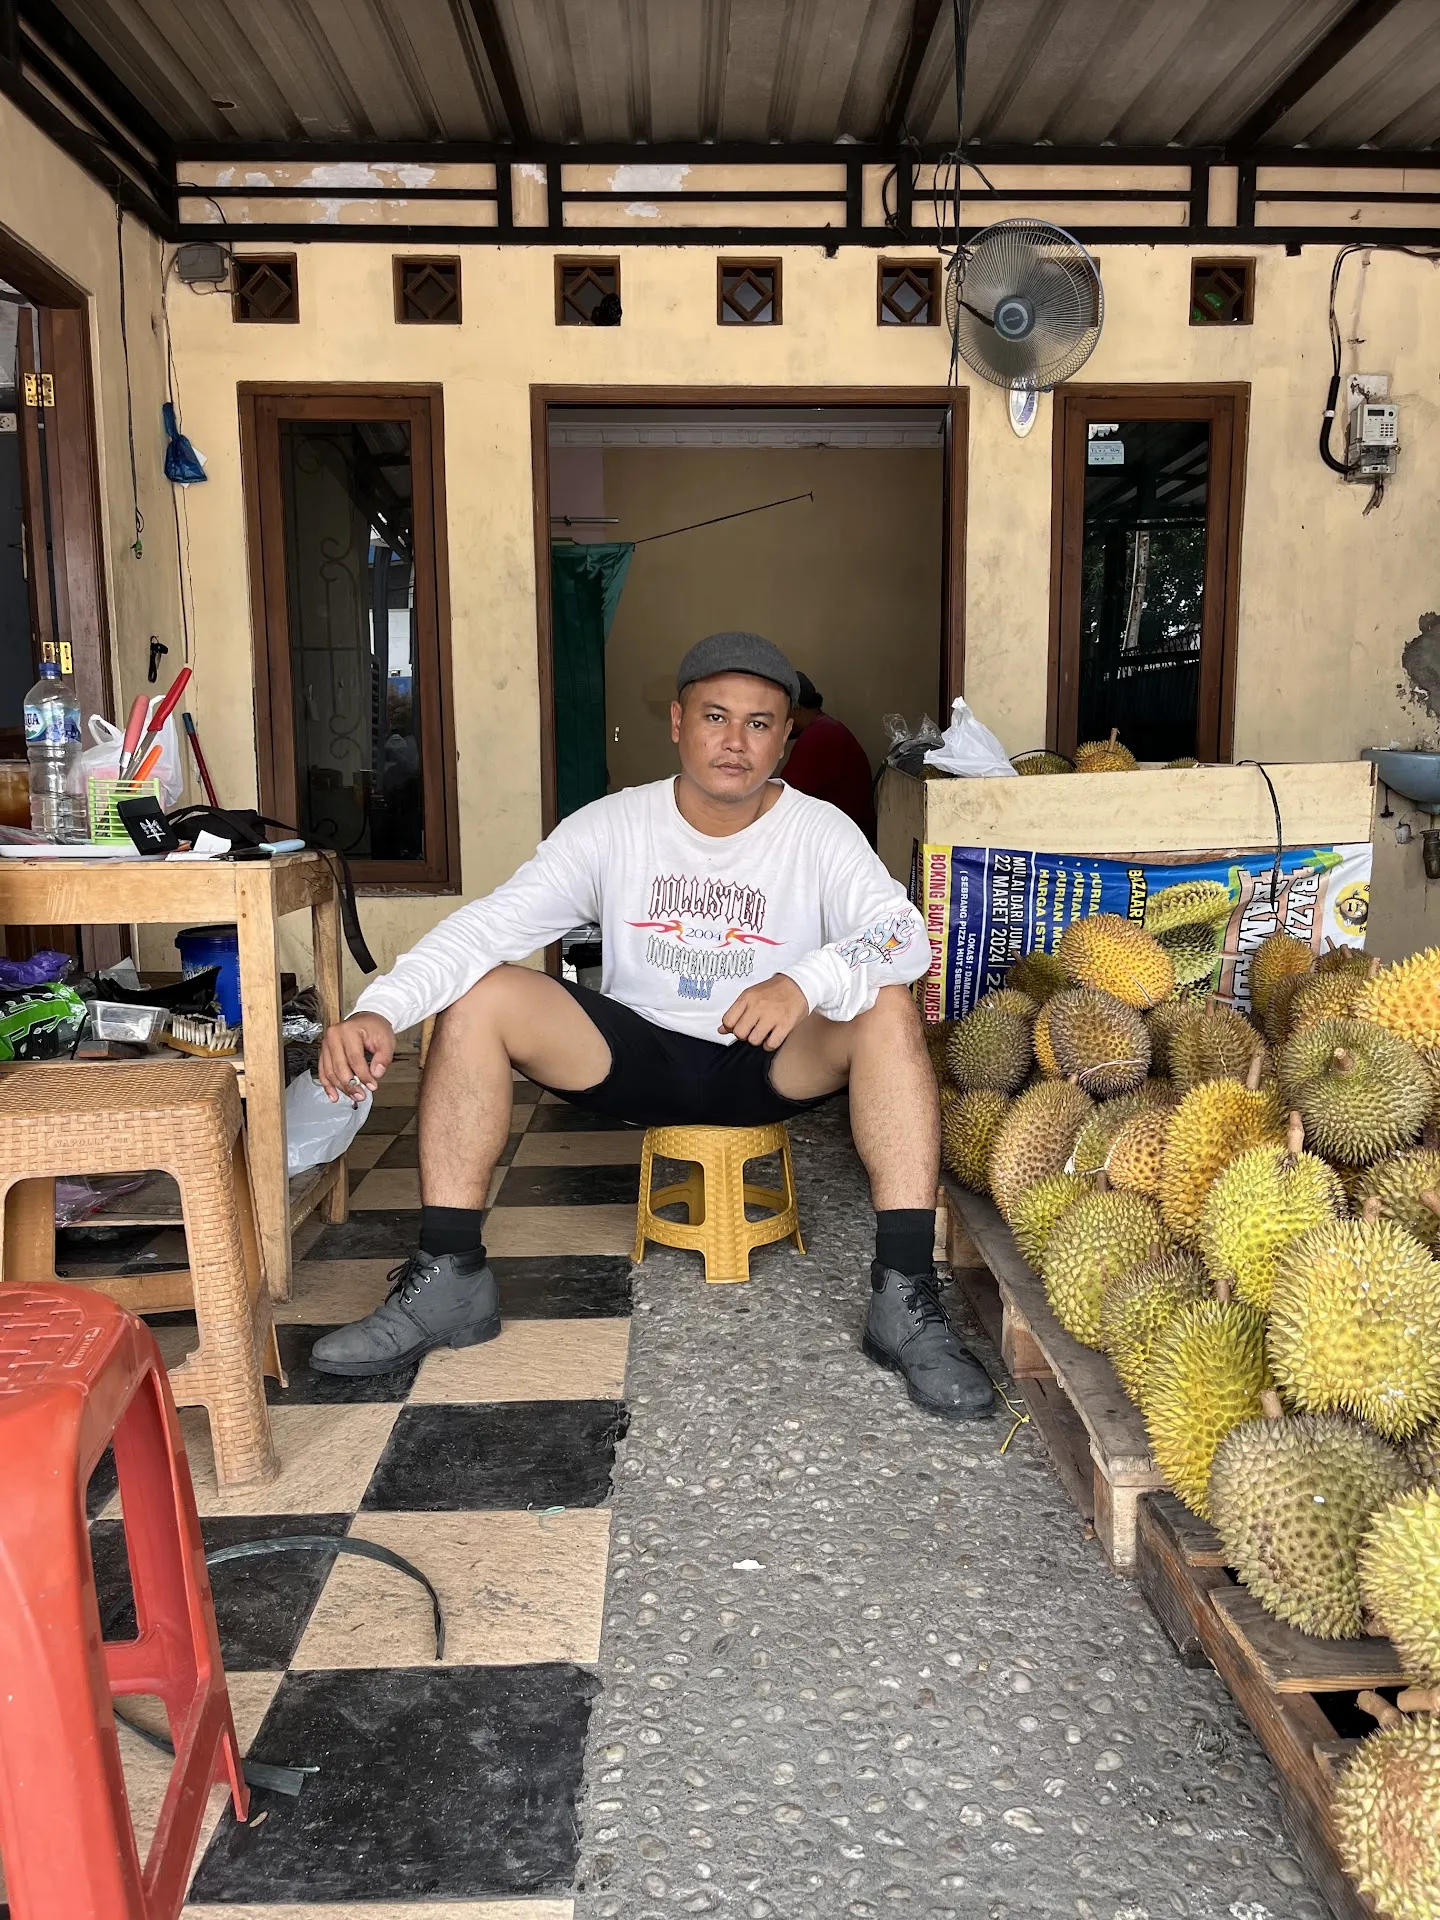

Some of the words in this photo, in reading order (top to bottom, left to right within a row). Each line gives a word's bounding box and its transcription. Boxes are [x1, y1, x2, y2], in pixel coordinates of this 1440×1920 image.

[929, 854, 947, 899] BOKING
[994, 854, 1011, 871] 22
[1010, 856, 1026, 891] MULAI
[648, 874, 767, 934] HOLLISTER
[959, 875, 969, 919] SEBRANG
[991, 876, 1010, 924] MARET
[1010, 895, 1024, 922] DARI
[1036, 869, 1050, 917] HARGA
[1053, 869, 1067, 922] DURIAN
[1071, 871, 1084, 922] DURIAN
[1128, 869, 1147, 918] BAZAAR
[685, 927, 722, 941] 2004
[927, 903, 944, 934] BUAT
[957, 920, 968, 947] PIZZA
[646, 934, 756, 980] INDEPENDENCE
[955, 948, 965, 966] HUT
[965, 933, 976, 964] LOKASI
[988, 928, 1008, 963] 2024
[953, 968, 963, 1009] SEBELUM
